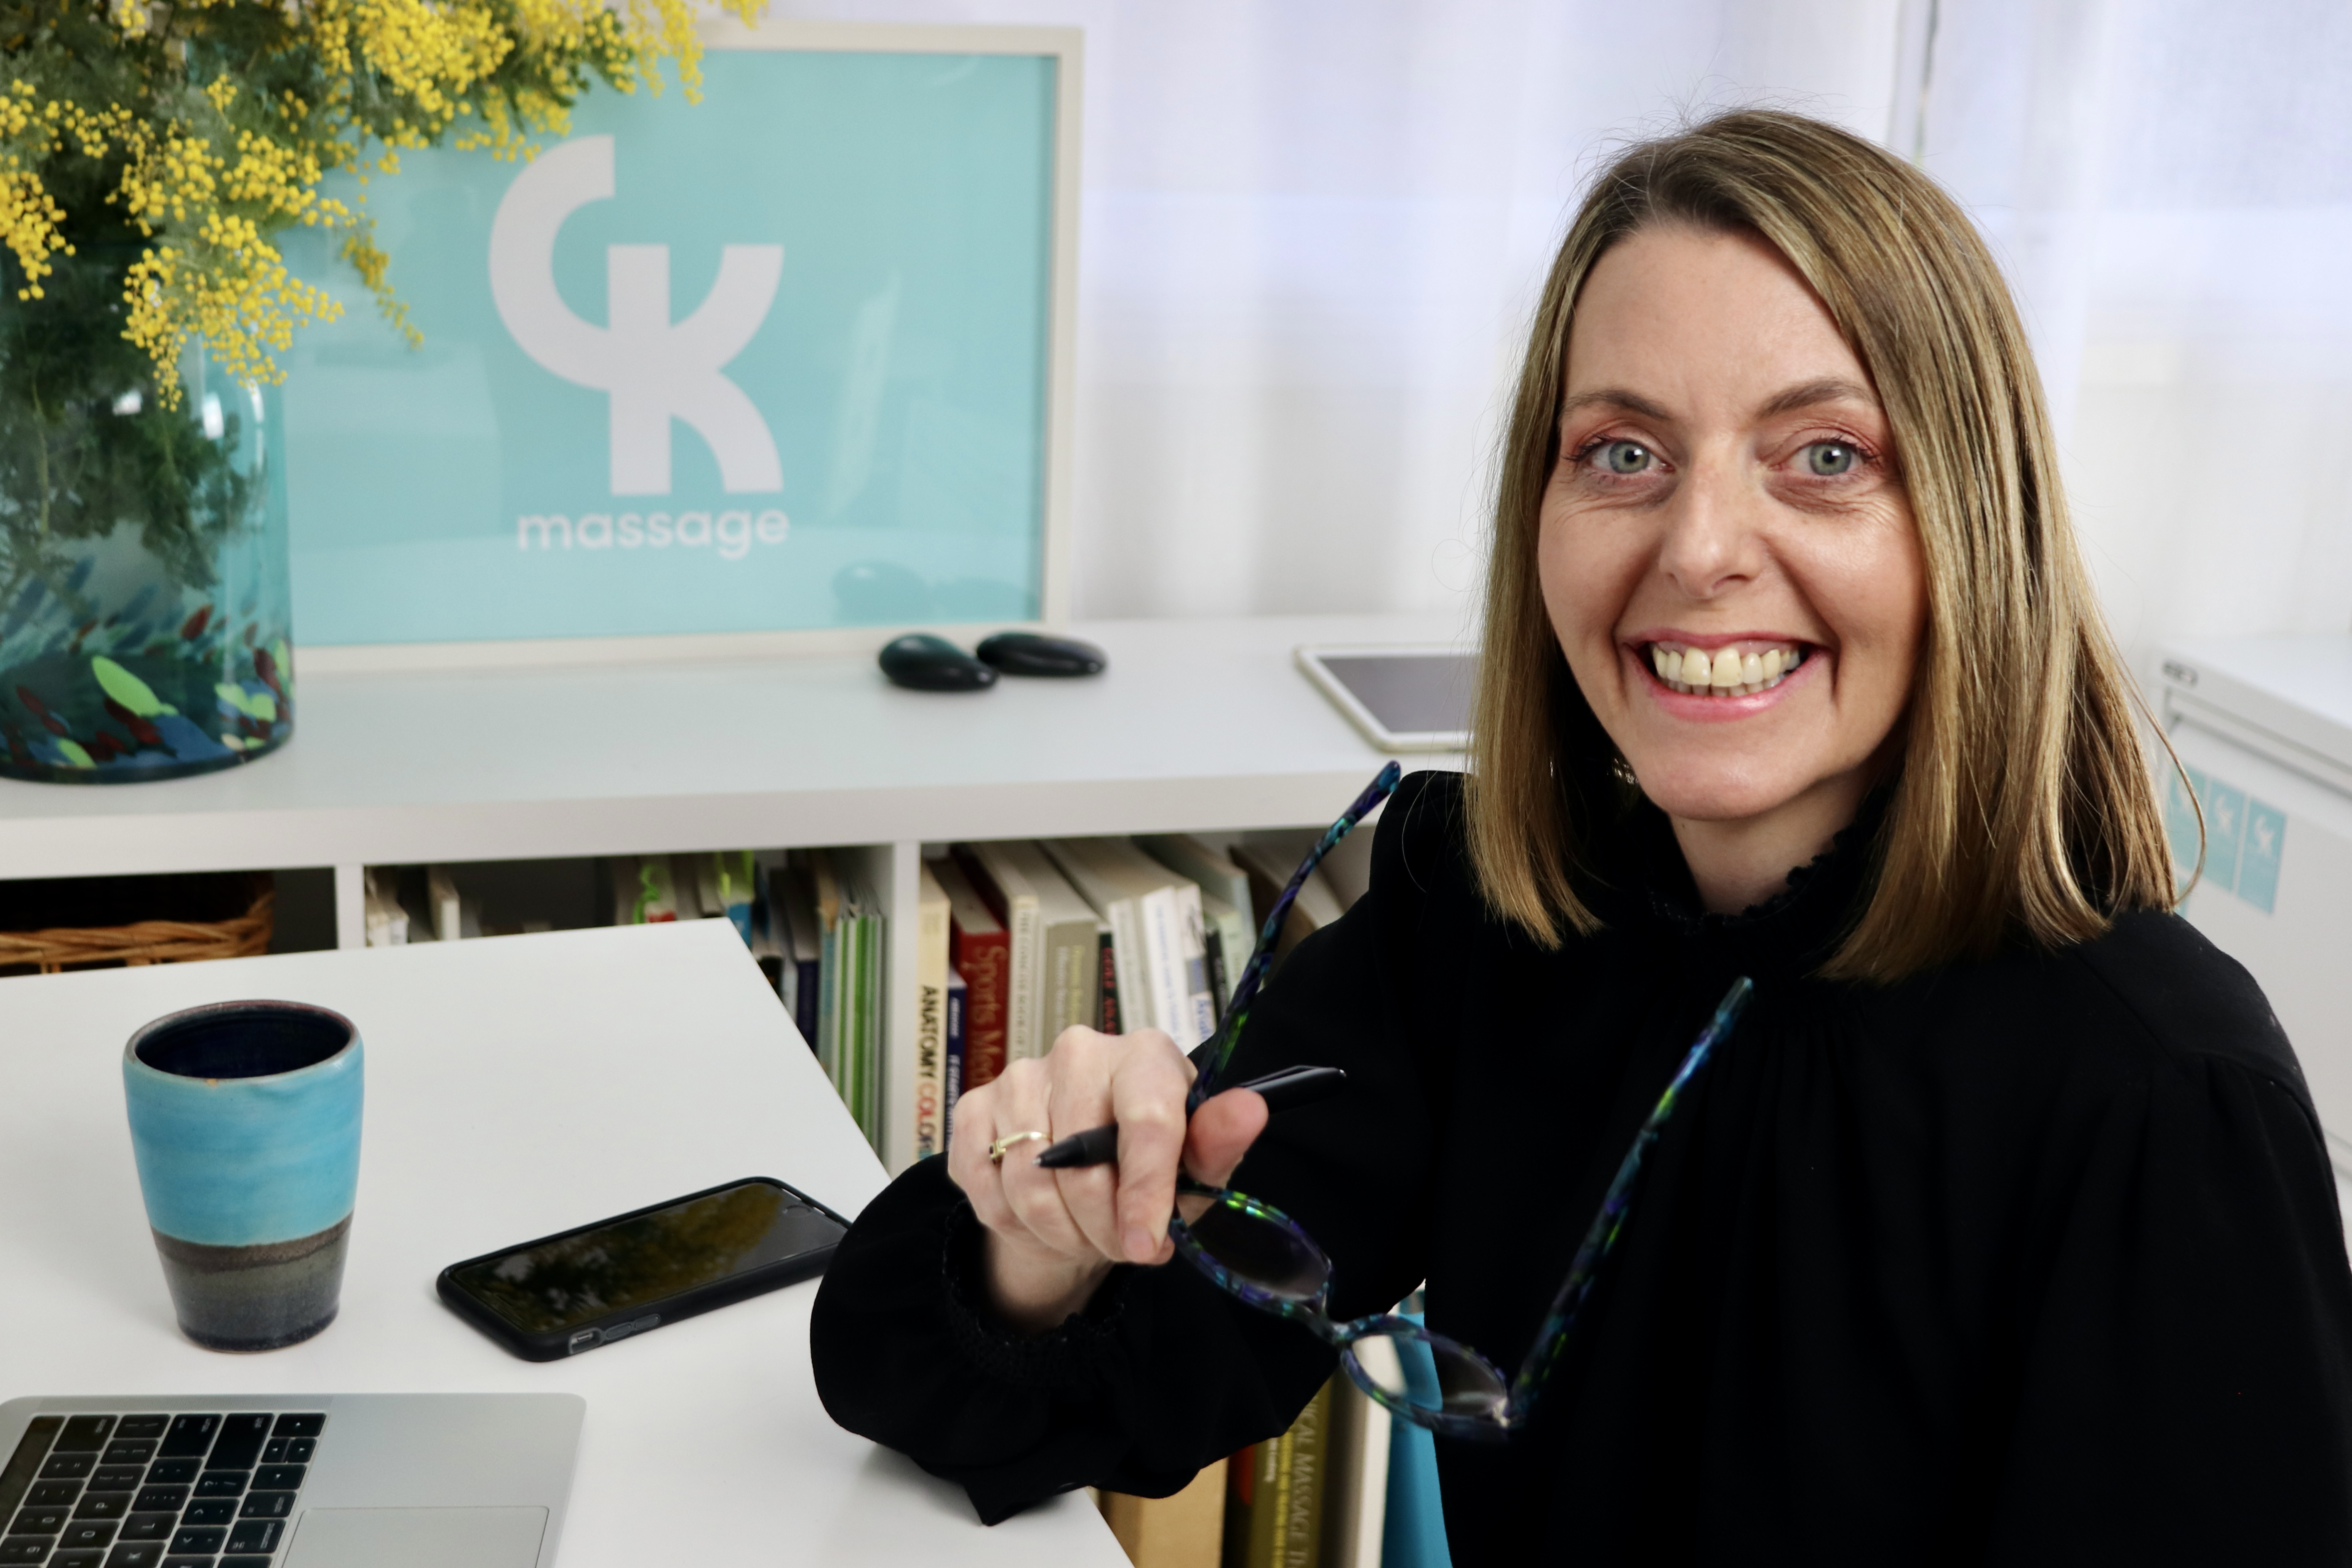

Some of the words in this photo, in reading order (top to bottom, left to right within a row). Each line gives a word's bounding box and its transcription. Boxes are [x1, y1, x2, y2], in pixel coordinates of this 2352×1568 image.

[488, 134, 785, 495] CK
[517, 509, 789, 560] massage
[964, 945, 1007, 1023] Sports
[918, 985, 939, 1078] ANATOMY
[968, 1030, 1002, 1086] Med
[1288, 1452, 1316, 1541] MASSAGE
